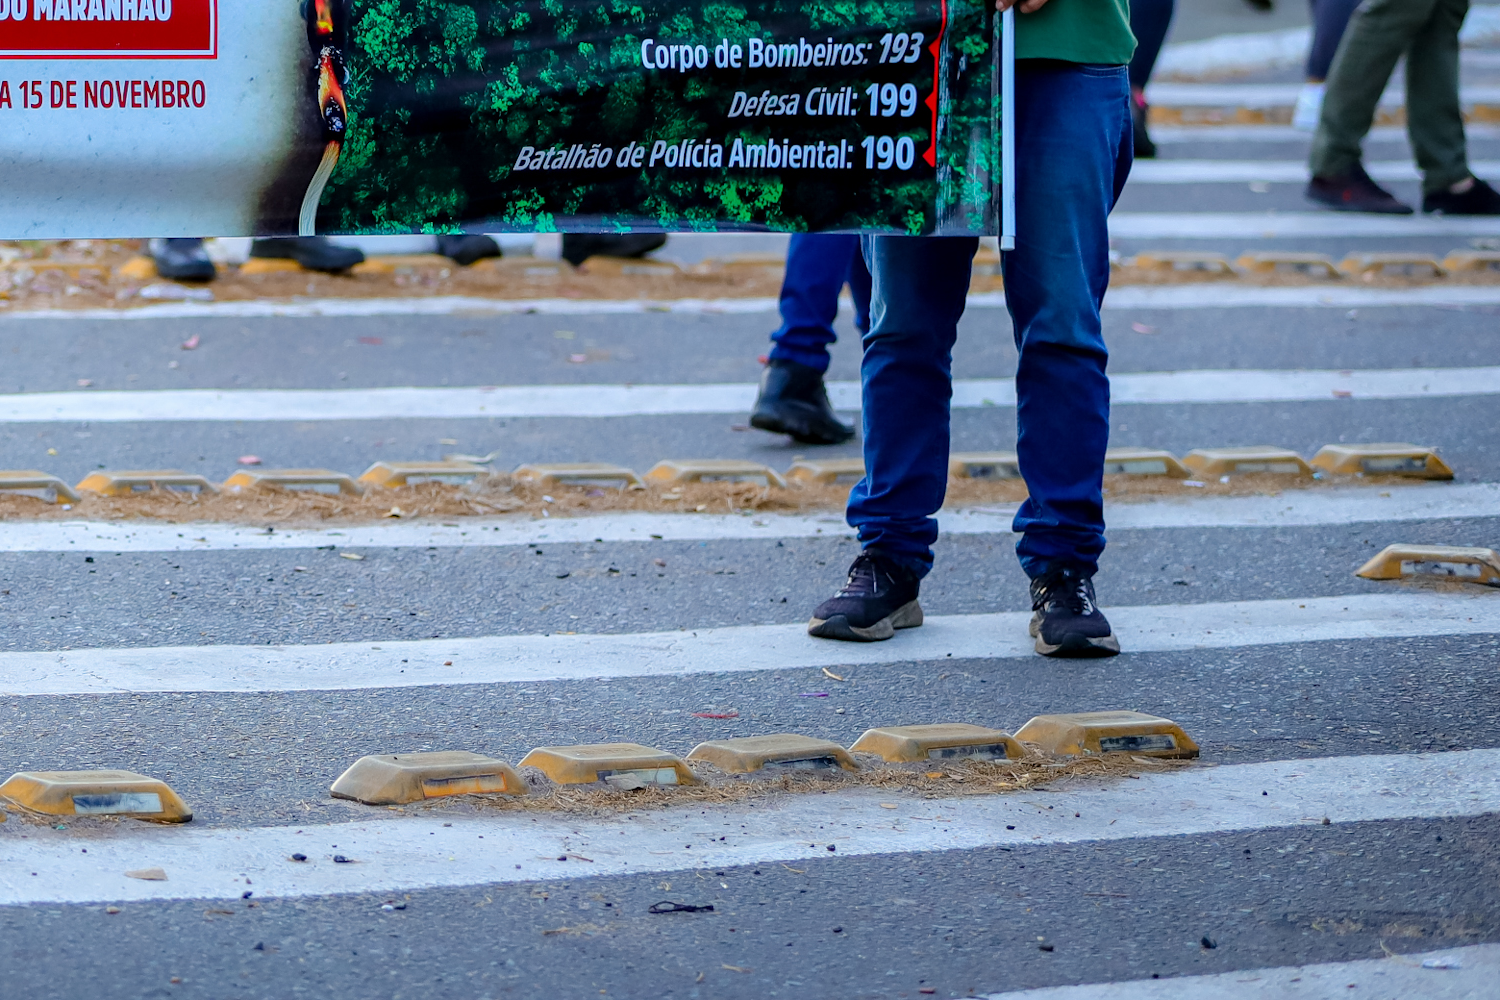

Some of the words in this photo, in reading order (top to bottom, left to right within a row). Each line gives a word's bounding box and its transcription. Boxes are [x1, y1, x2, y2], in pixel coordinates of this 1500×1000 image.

[640, 38, 708, 73] Corpo
[714, 37, 742, 68] de
[748, 36, 871, 68] Bombeiros:
[878, 31, 923, 64] 193
[19, 80, 44, 109] 15
[50, 80, 77, 108] DE
[84, 79, 206, 108] NOVEMBRO
[727, 90, 800, 118] Defesa
[804, 86, 858, 117] Civil:
[864, 83, 918, 117] 199
[513, 142, 613, 171] Batalhão
[616, 139, 645, 169] de
[649, 139, 723, 169] Polícia
[728, 137, 854, 170] Ambiental:
[860, 135, 915, 170] 190
